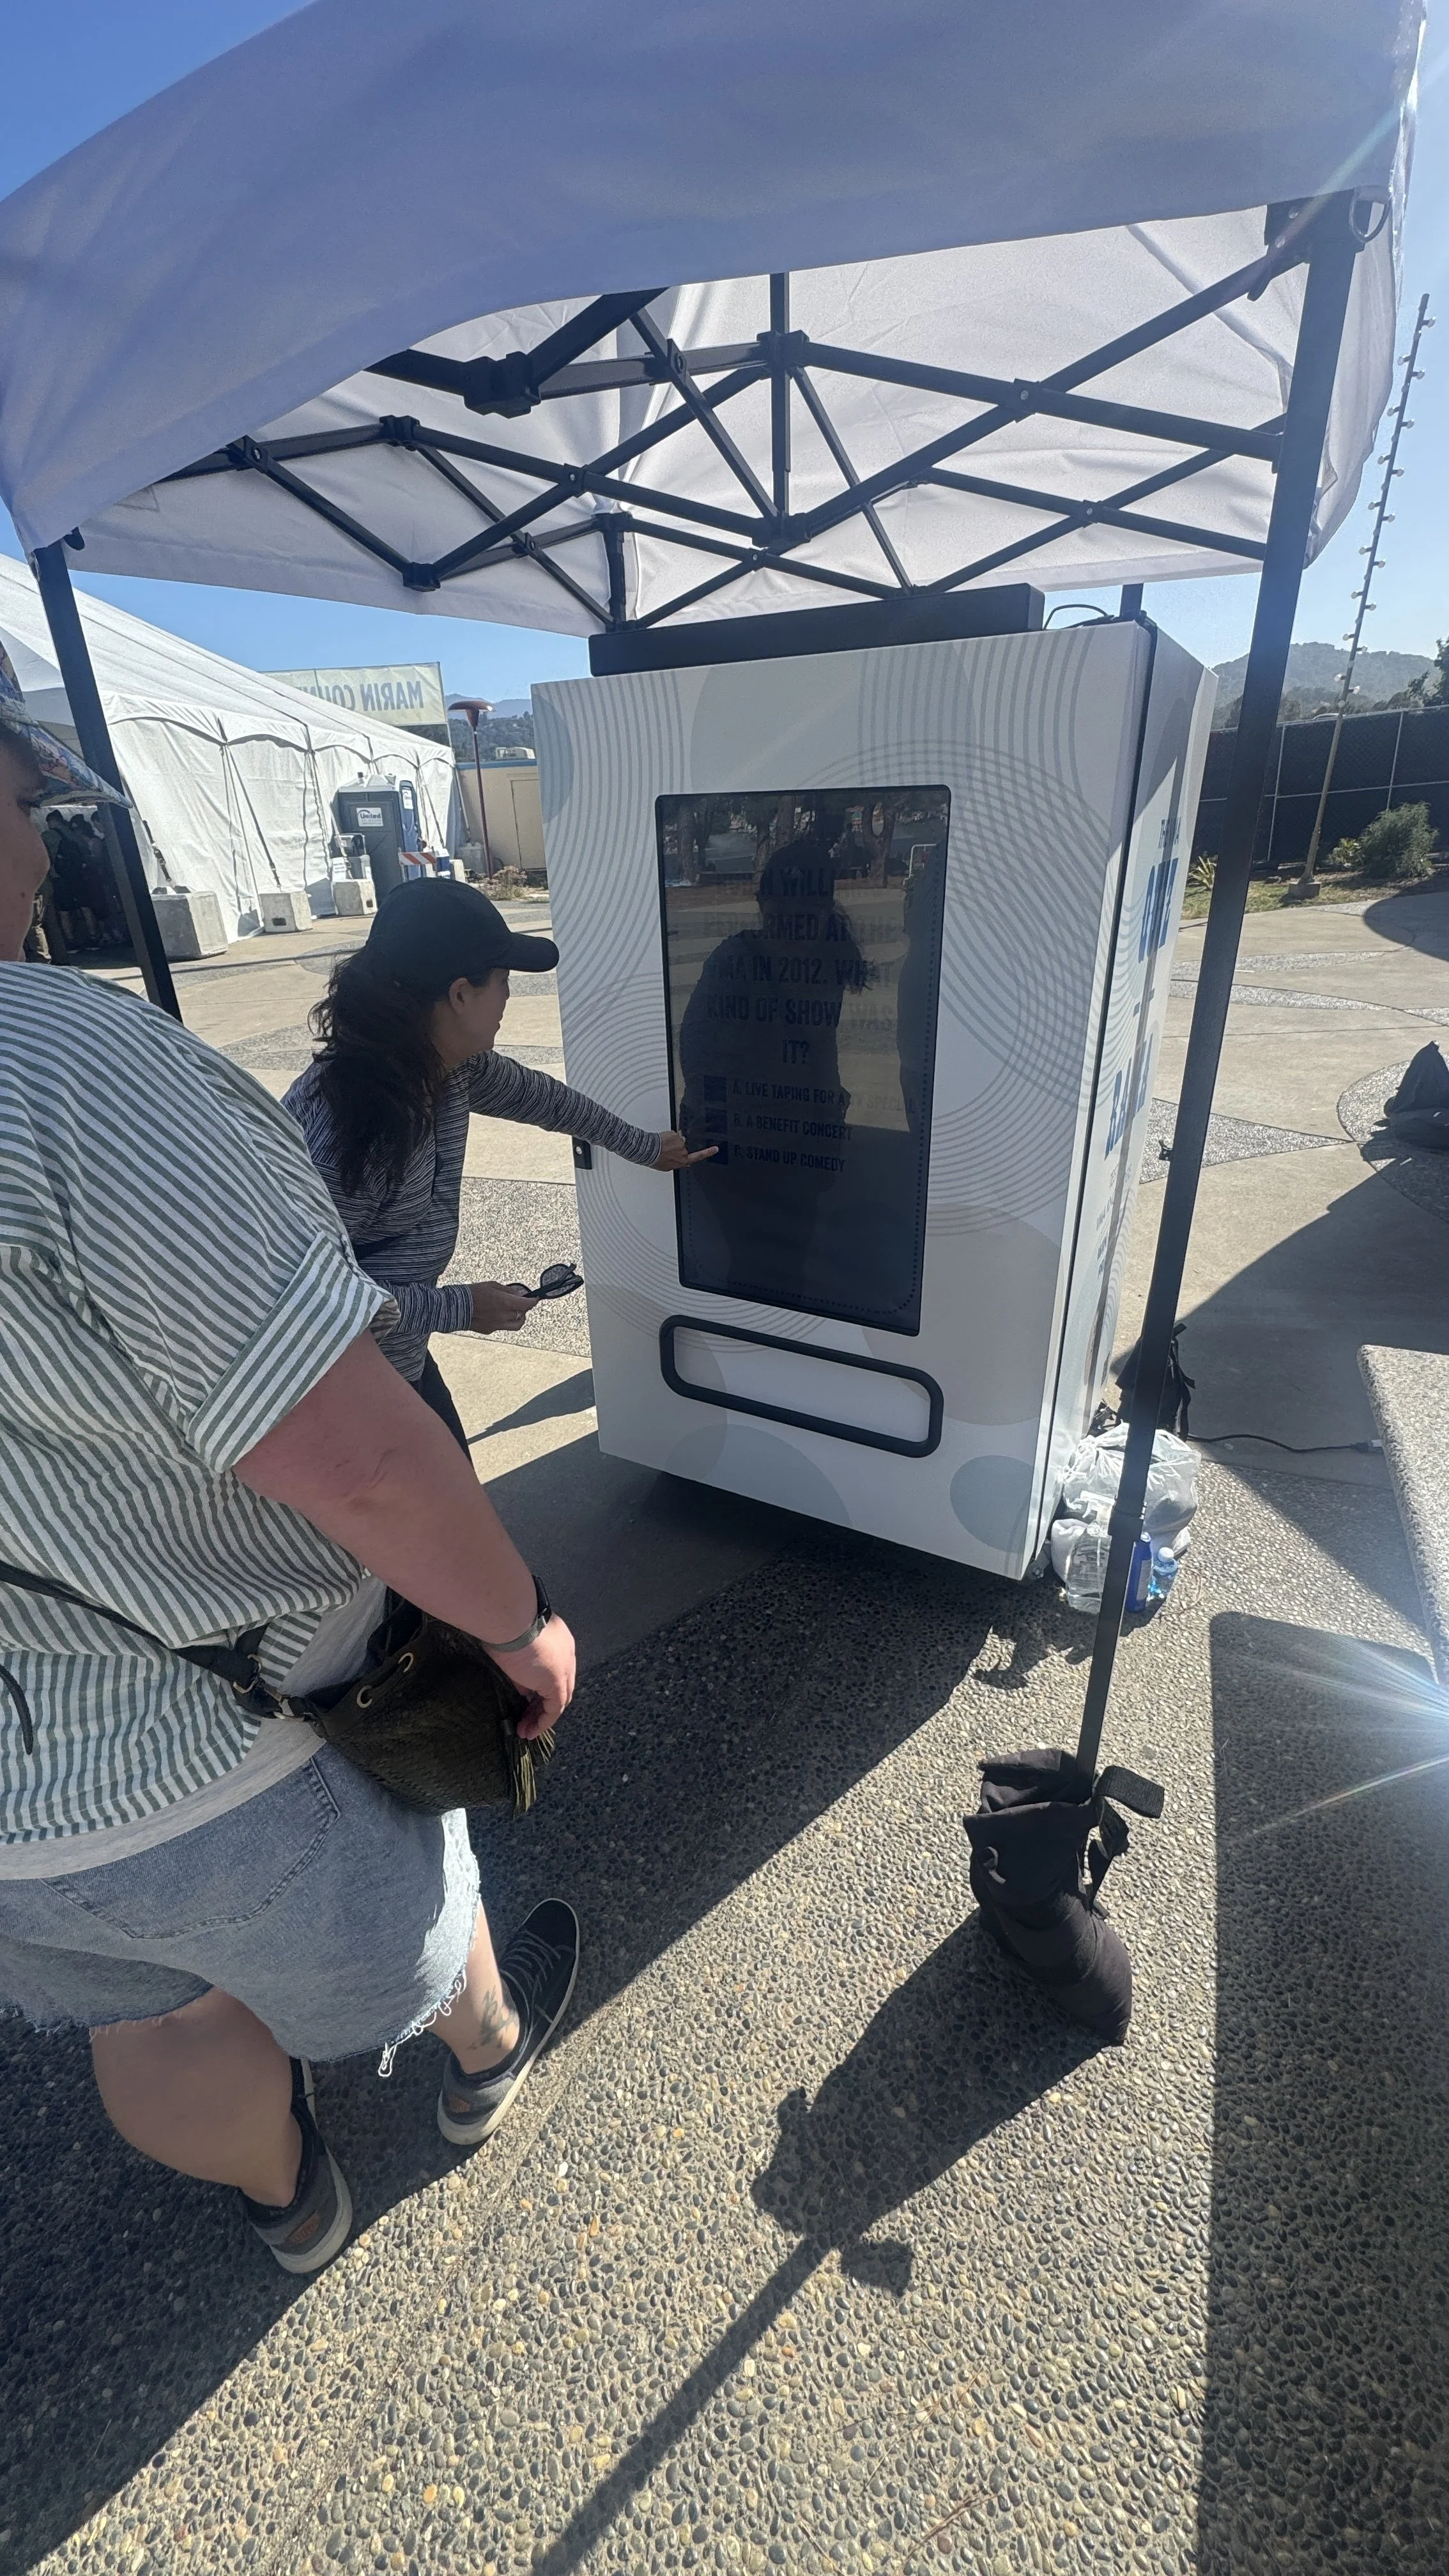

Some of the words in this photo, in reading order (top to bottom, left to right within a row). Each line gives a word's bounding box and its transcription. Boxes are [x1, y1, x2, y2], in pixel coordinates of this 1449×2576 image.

[752, 956, 772, 983] IN
[778, 956, 828, 985] 2012.
[707, 995, 750, 1022] KIND
[755, 997, 779, 1023] OF
[785, 998, 841, 1028] SHOW
[781, 1039, 810, 1065] IT?
[745, 1082, 769, 1098] LIVE
[772, 1084, 810, 1103] TAPING
[814, 1089, 834, 1105] FOR
[838, 1092, 846, 1107] A
[746, 1114, 754, 1129] A
[756, 1114, 801, 1135] BENEFIT
[802, 1121, 854, 1142] CONCERT
[746, 1146, 780, 1164] STAND
[783, 1151, 797, 1166] UP
[800, 1153, 847, 1174] COMEDY
